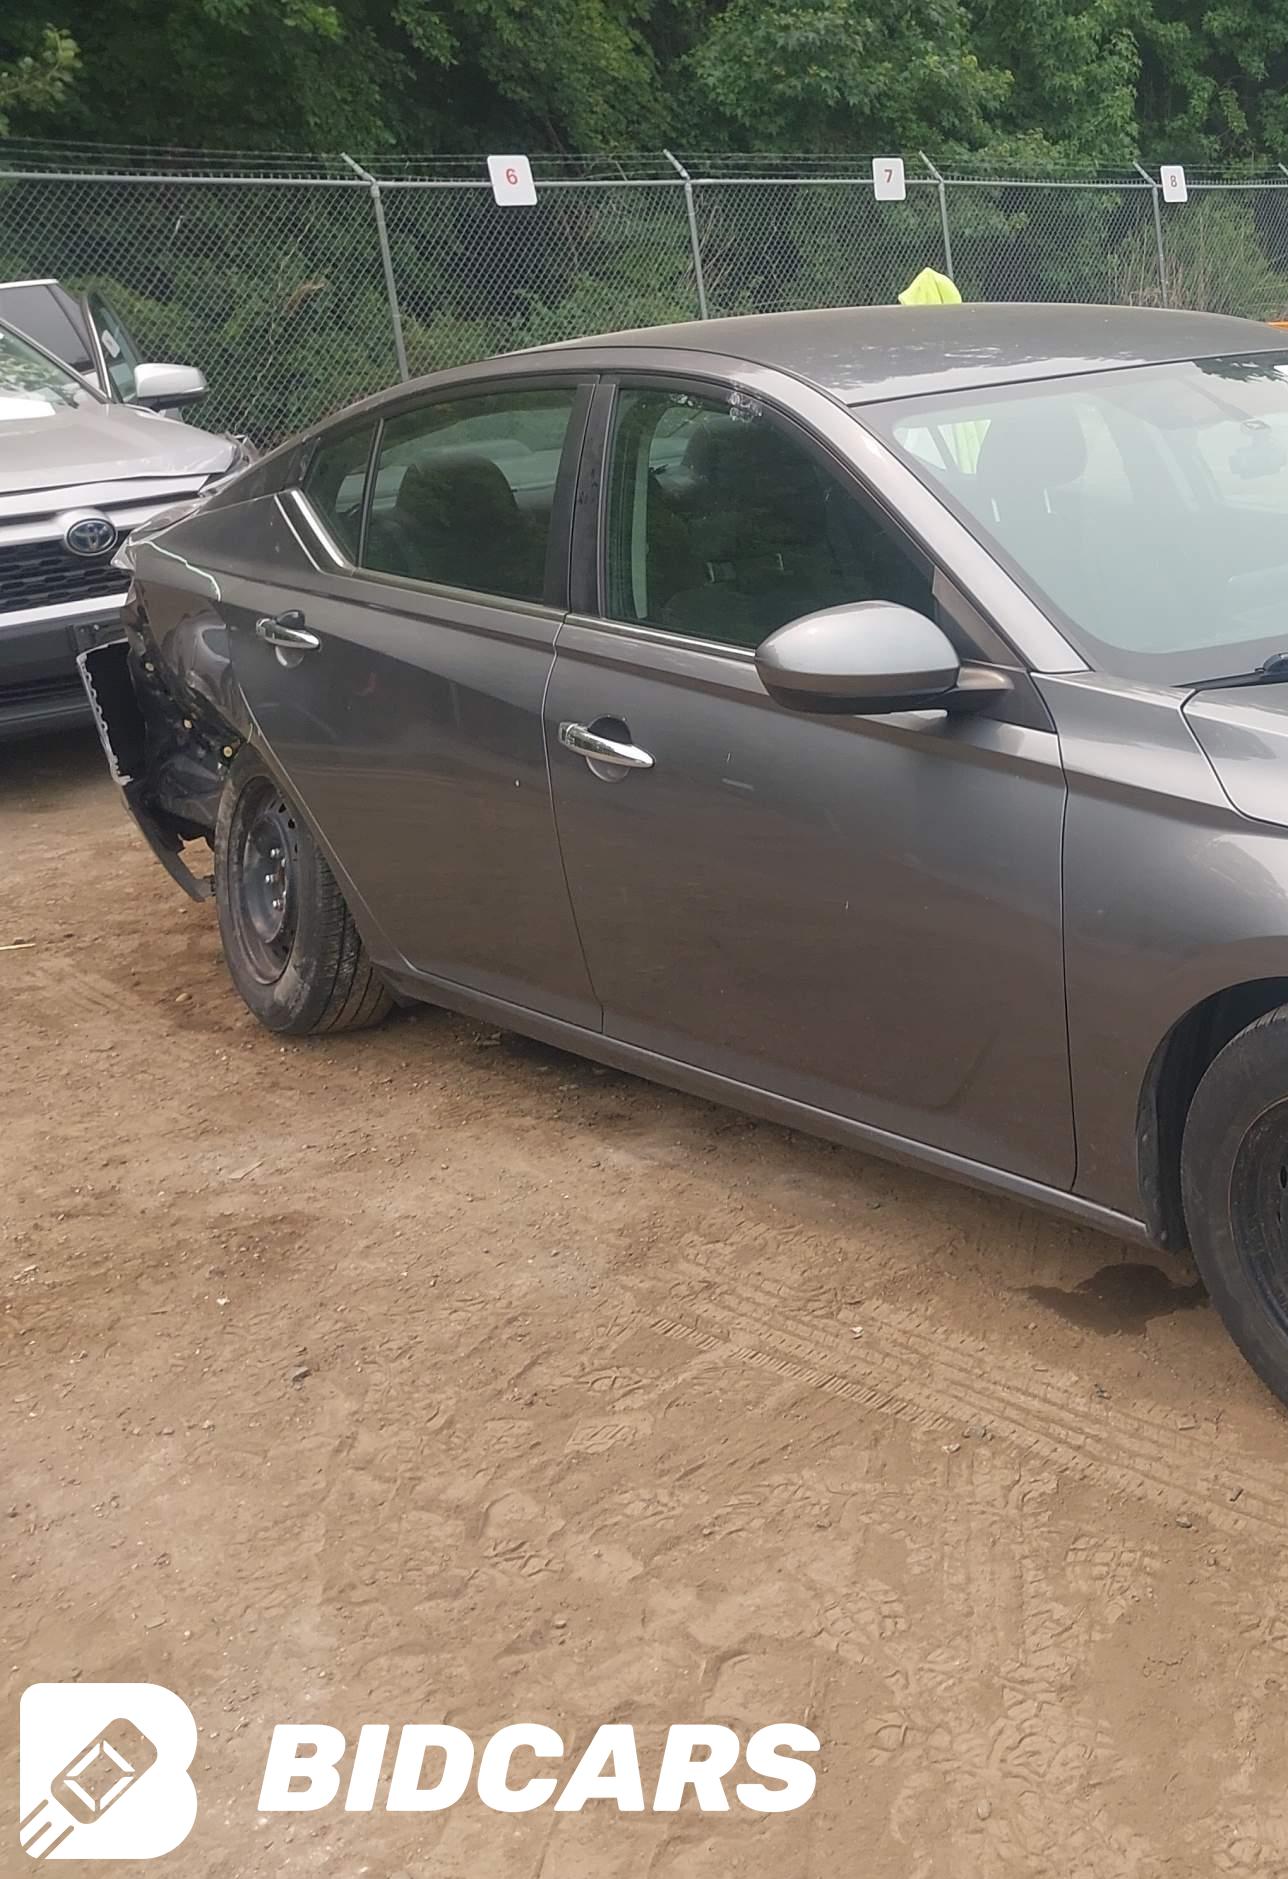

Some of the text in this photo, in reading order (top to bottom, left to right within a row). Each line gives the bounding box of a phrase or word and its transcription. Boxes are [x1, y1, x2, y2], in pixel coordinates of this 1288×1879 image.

[505, 168, 519, 185] 6
[883, 168, 893, 184] 7
[1169, 174, 1178, 188] 8
